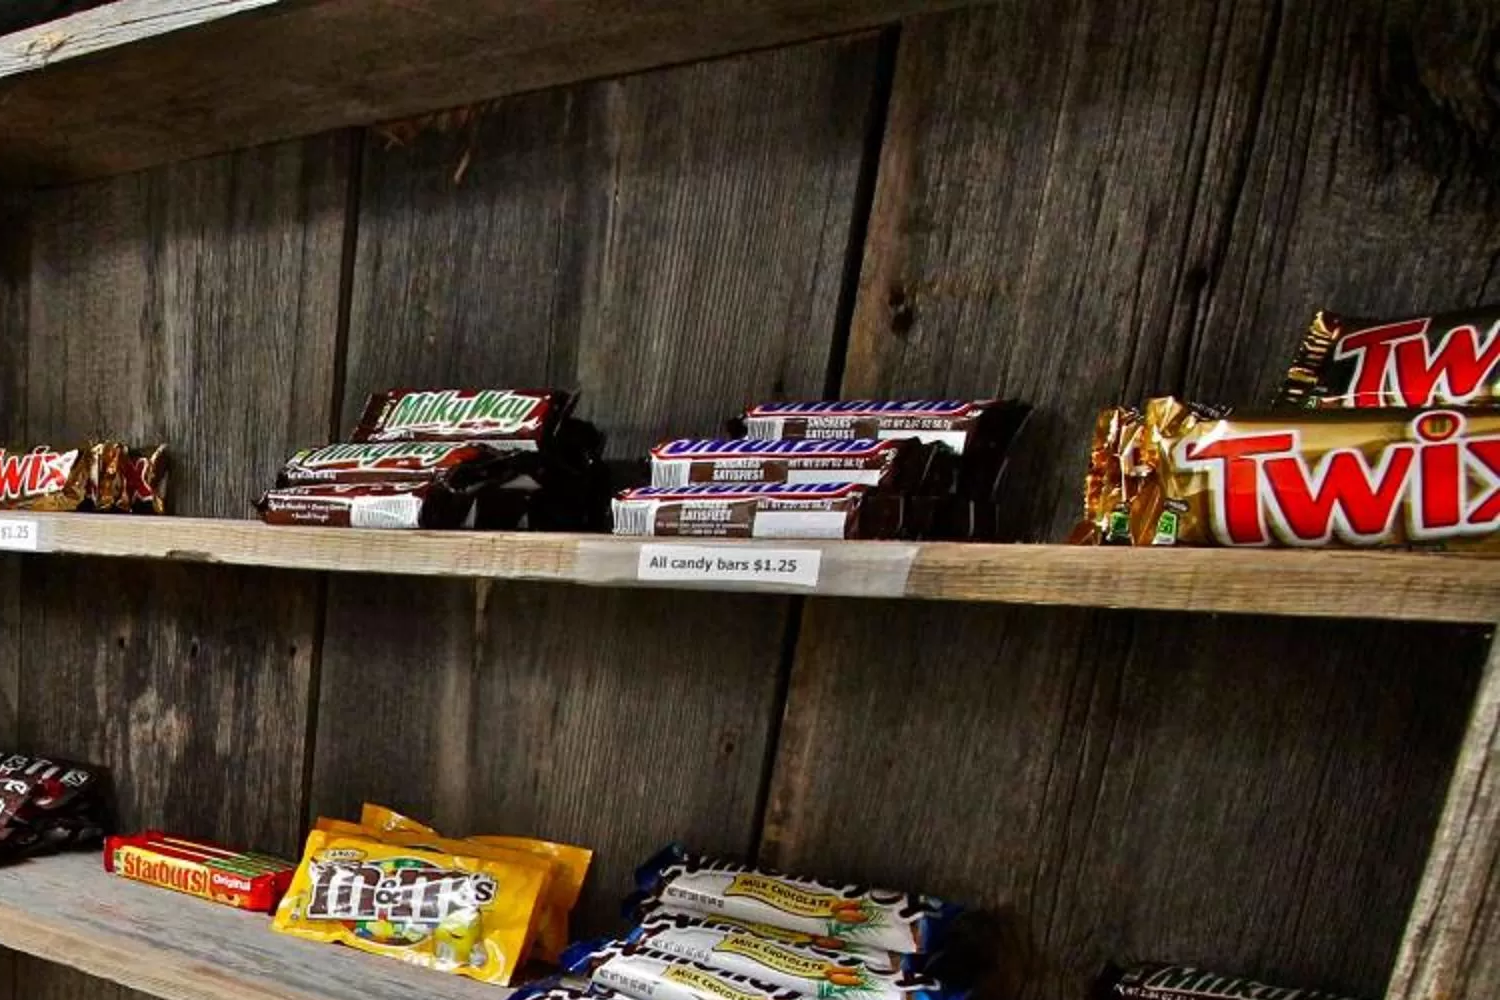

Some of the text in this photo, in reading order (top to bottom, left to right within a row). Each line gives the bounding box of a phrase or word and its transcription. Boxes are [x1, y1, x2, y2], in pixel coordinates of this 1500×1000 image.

[650, 556, 797, 573] All candy bars $1.25
[123, 850, 251, 895] Starburst Original
[740, 877, 832, 909] MILK CHOCOLATE
[731, 935, 825, 973] MILK CHOCOLATE
[672, 969, 701, 986] MILK
